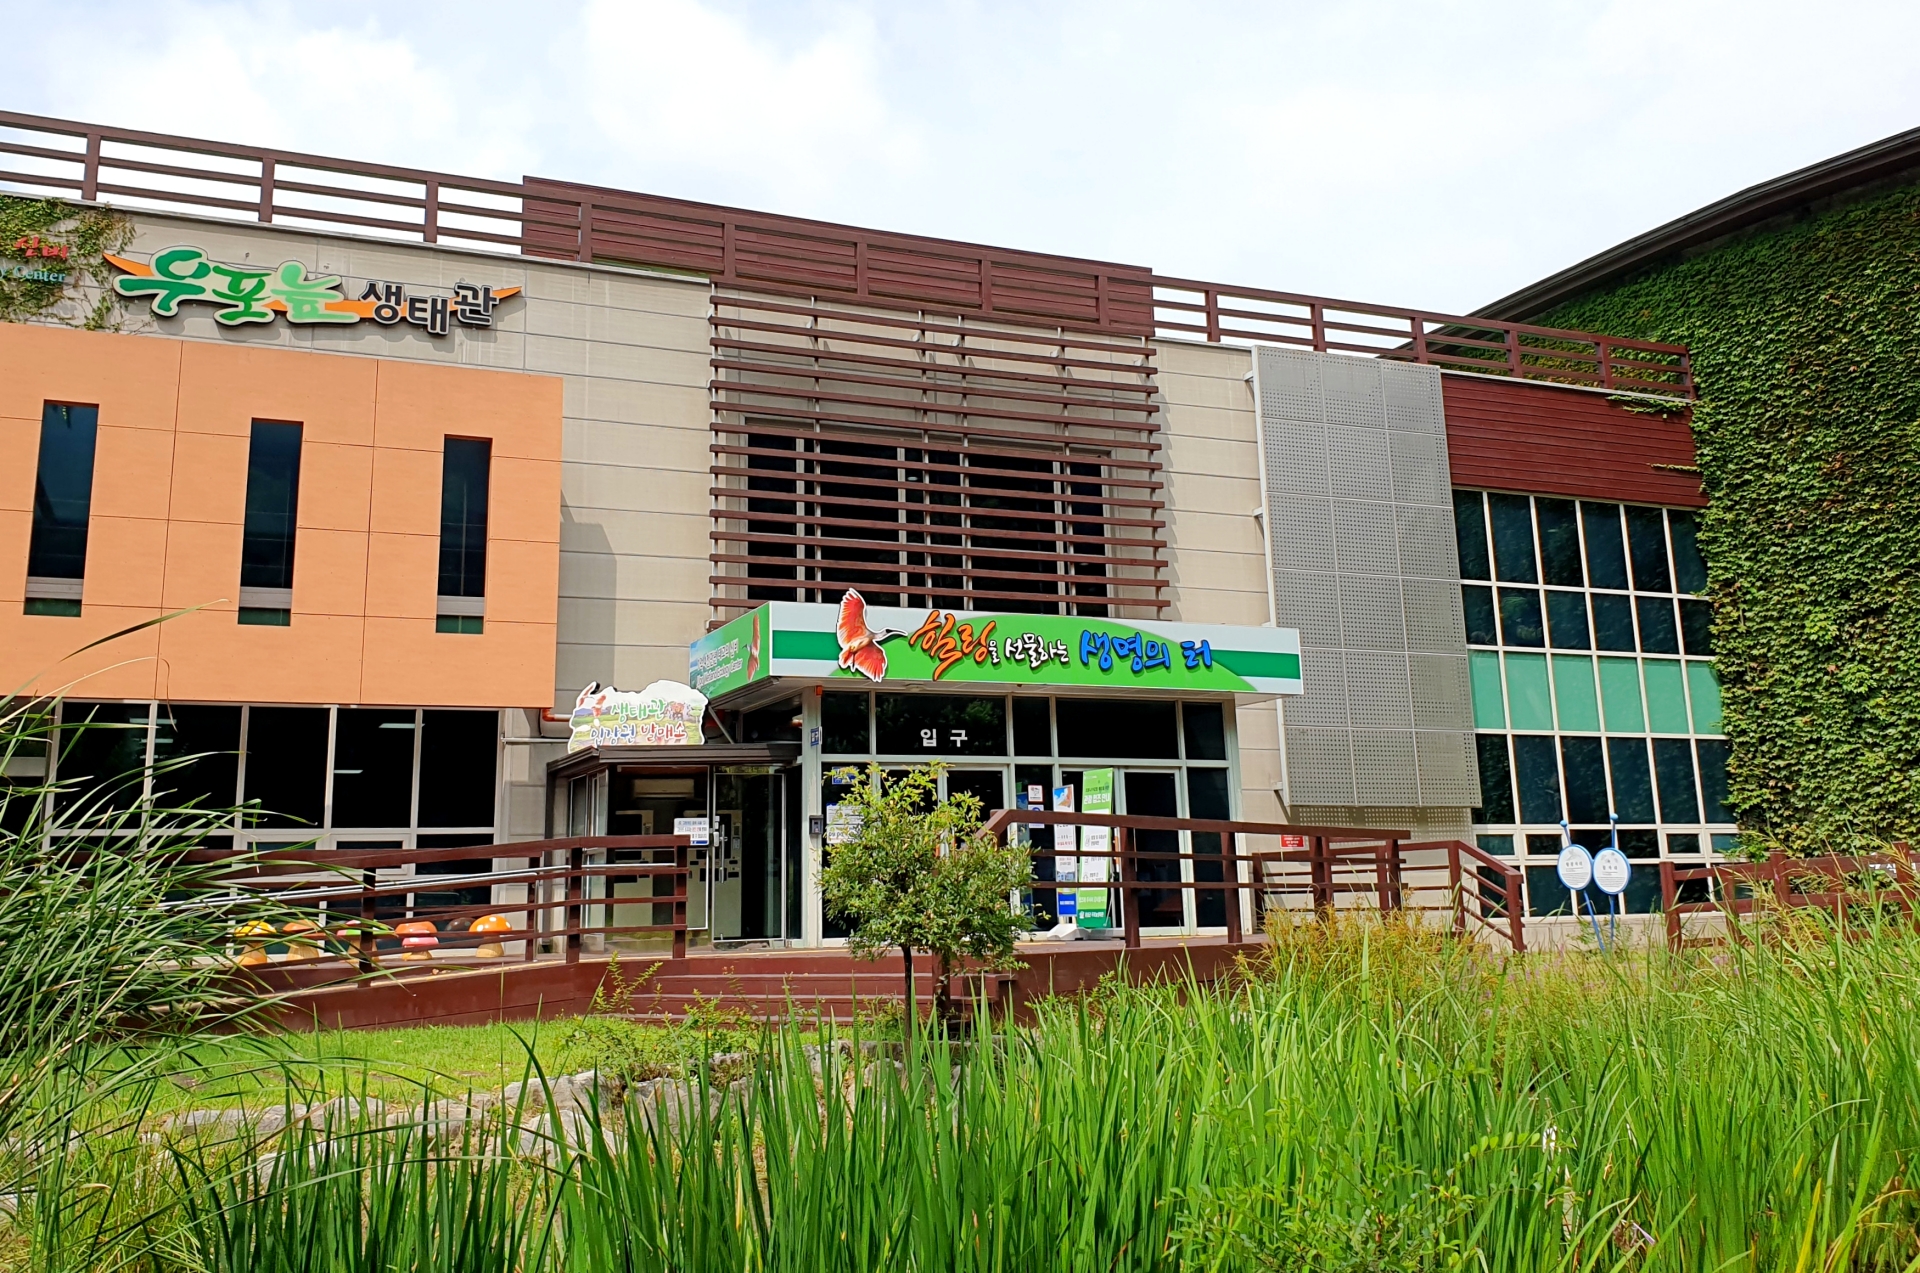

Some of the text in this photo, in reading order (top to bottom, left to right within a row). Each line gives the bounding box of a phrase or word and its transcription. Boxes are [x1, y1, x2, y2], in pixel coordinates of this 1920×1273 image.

[13, 266, 66, 283] Center
[116, 248, 499, 336] 우포늪 생태관
[1004, 632, 1070, 668] 선물하는
[1079, 629, 1171, 672] 생명의
[1180, 639, 1213, 668] 터
[730, 657, 743, 672] Center
[611, 699, 668, 723] 생태관
[591, 723, 686, 745] 입장권 발매소
